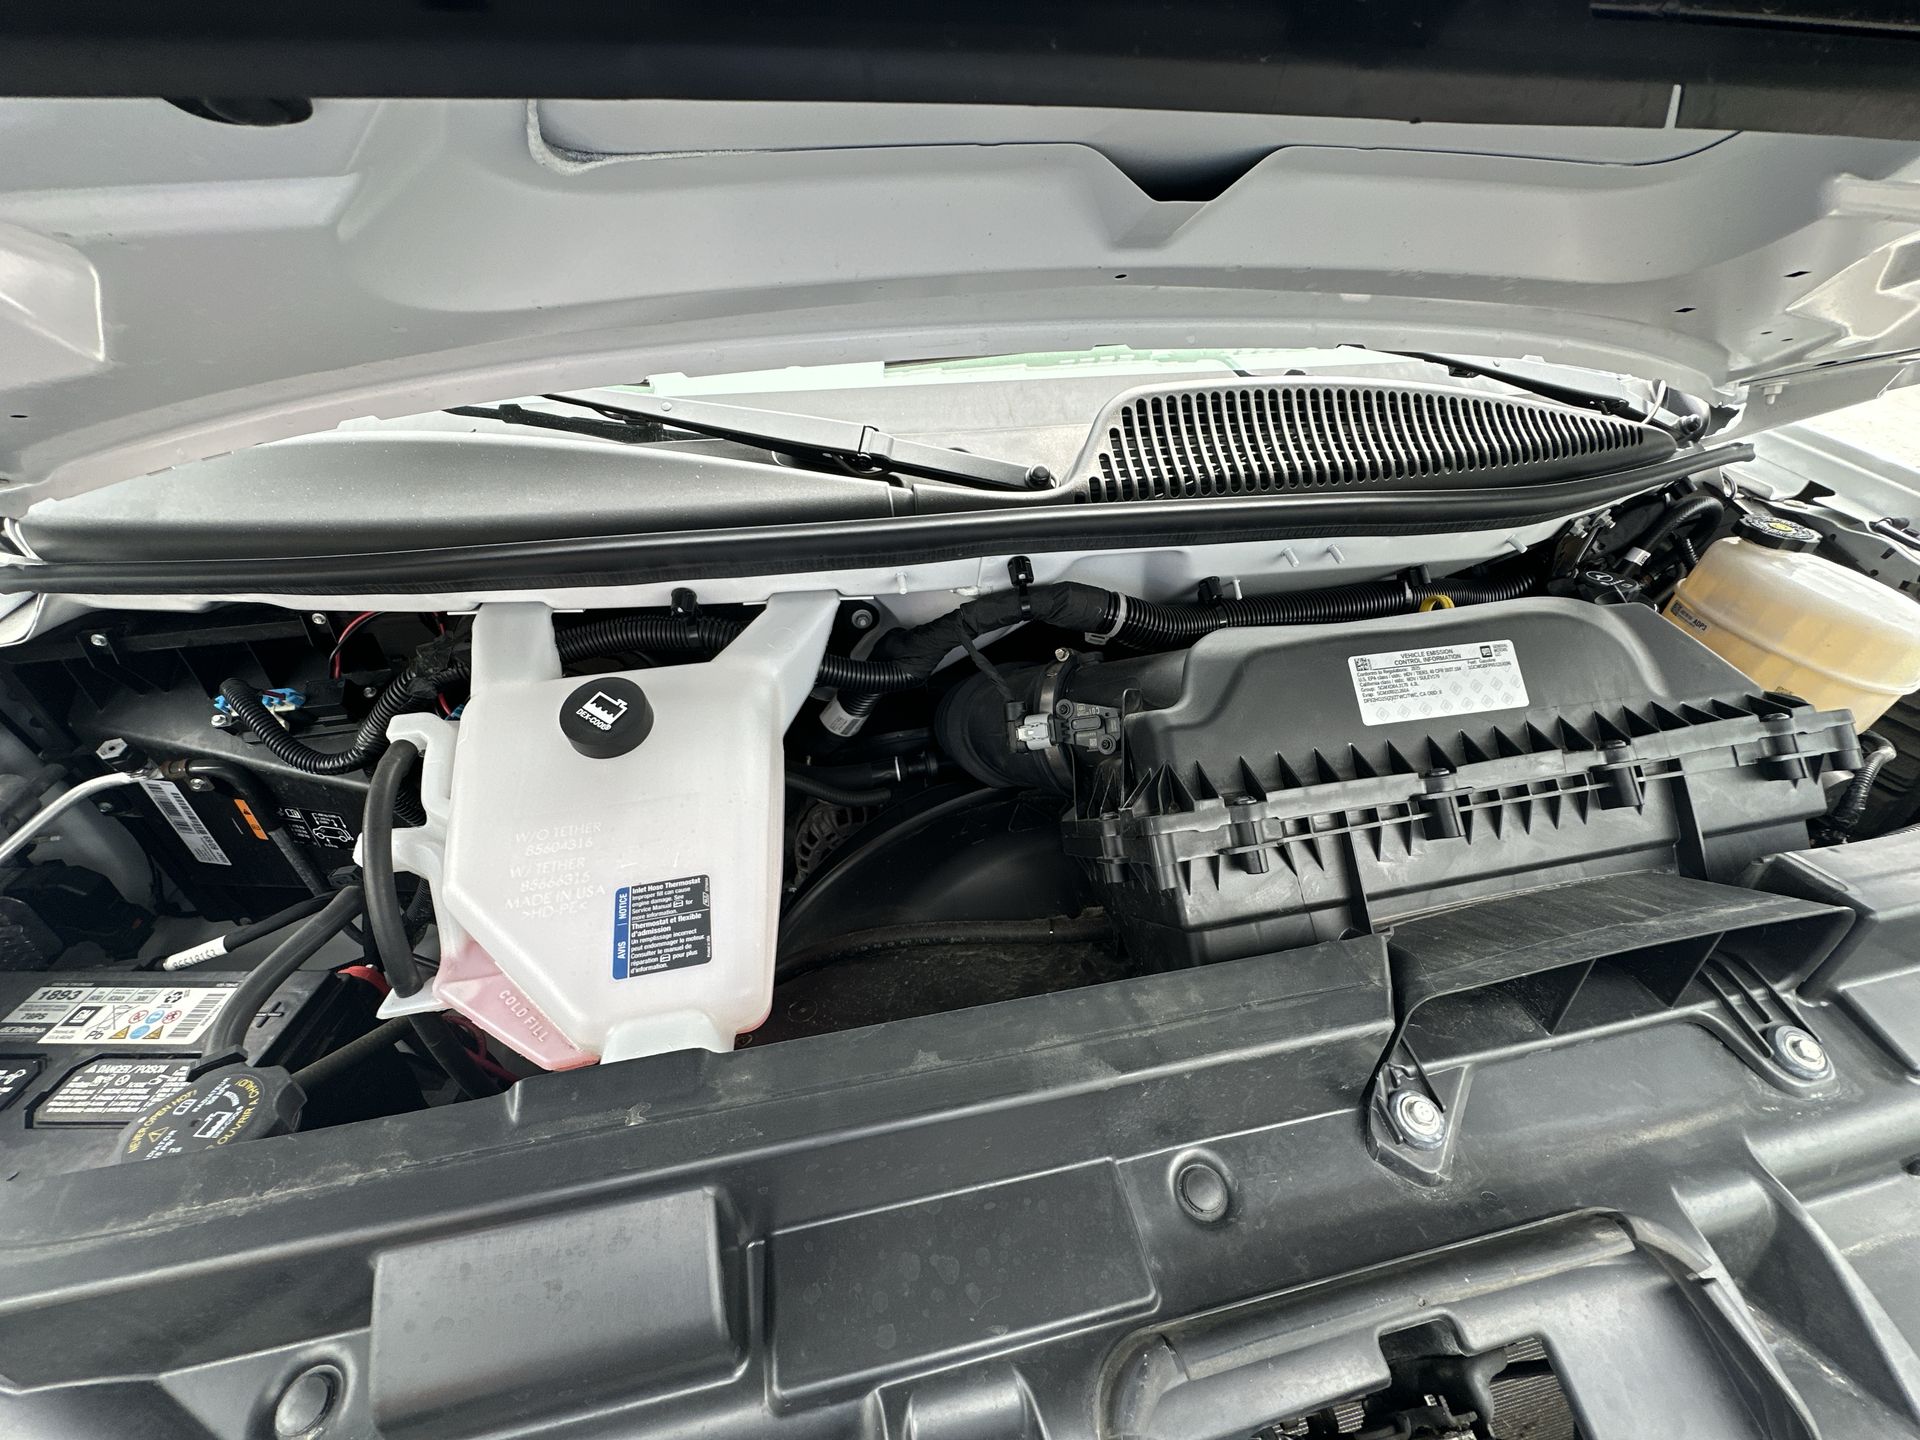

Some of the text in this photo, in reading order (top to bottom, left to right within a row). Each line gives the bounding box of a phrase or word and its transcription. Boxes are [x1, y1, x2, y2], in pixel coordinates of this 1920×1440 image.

[1394, 654, 1461, 666] CONTROL INFORMATION
[516, 822, 602, 842] W/O TETHER
[536, 857, 586, 874] TETHER
[648, 884, 664, 892] Hose
[665, 878, 701, 888] Thermostat
[505, 884, 606, 909] MADE IN USA
[618, 893, 627, 920] NOTICE
[632, 918, 668, 930] Thermostat
[678, 913, 702, 922] flexible
[631, 926, 671, 938] d'admission
[640, 933, 672, 943] remplissage
[673, 928, 697, 937] incorrect
[617, 941, 626, 959] AVIS
[631, 951, 656, 959] Consulter
[664, 945, 684, 953] manuel
[644, 939, 678, 949] endommager
[673, 952, 685, 960] pour
[38, 990, 83, 1000] 1893
[499, 990, 528, 1017] COLD
[84, 1031, 104, 1040] Pb
[524, 1016, 549, 1042] FILL
[128, 1127, 149, 1153] NEVER
[144, 1104, 172, 1126] OPEN
[171, 1089, 197, 1105] HOT!
[217, 1107, 255, 1144] OUVRIR
